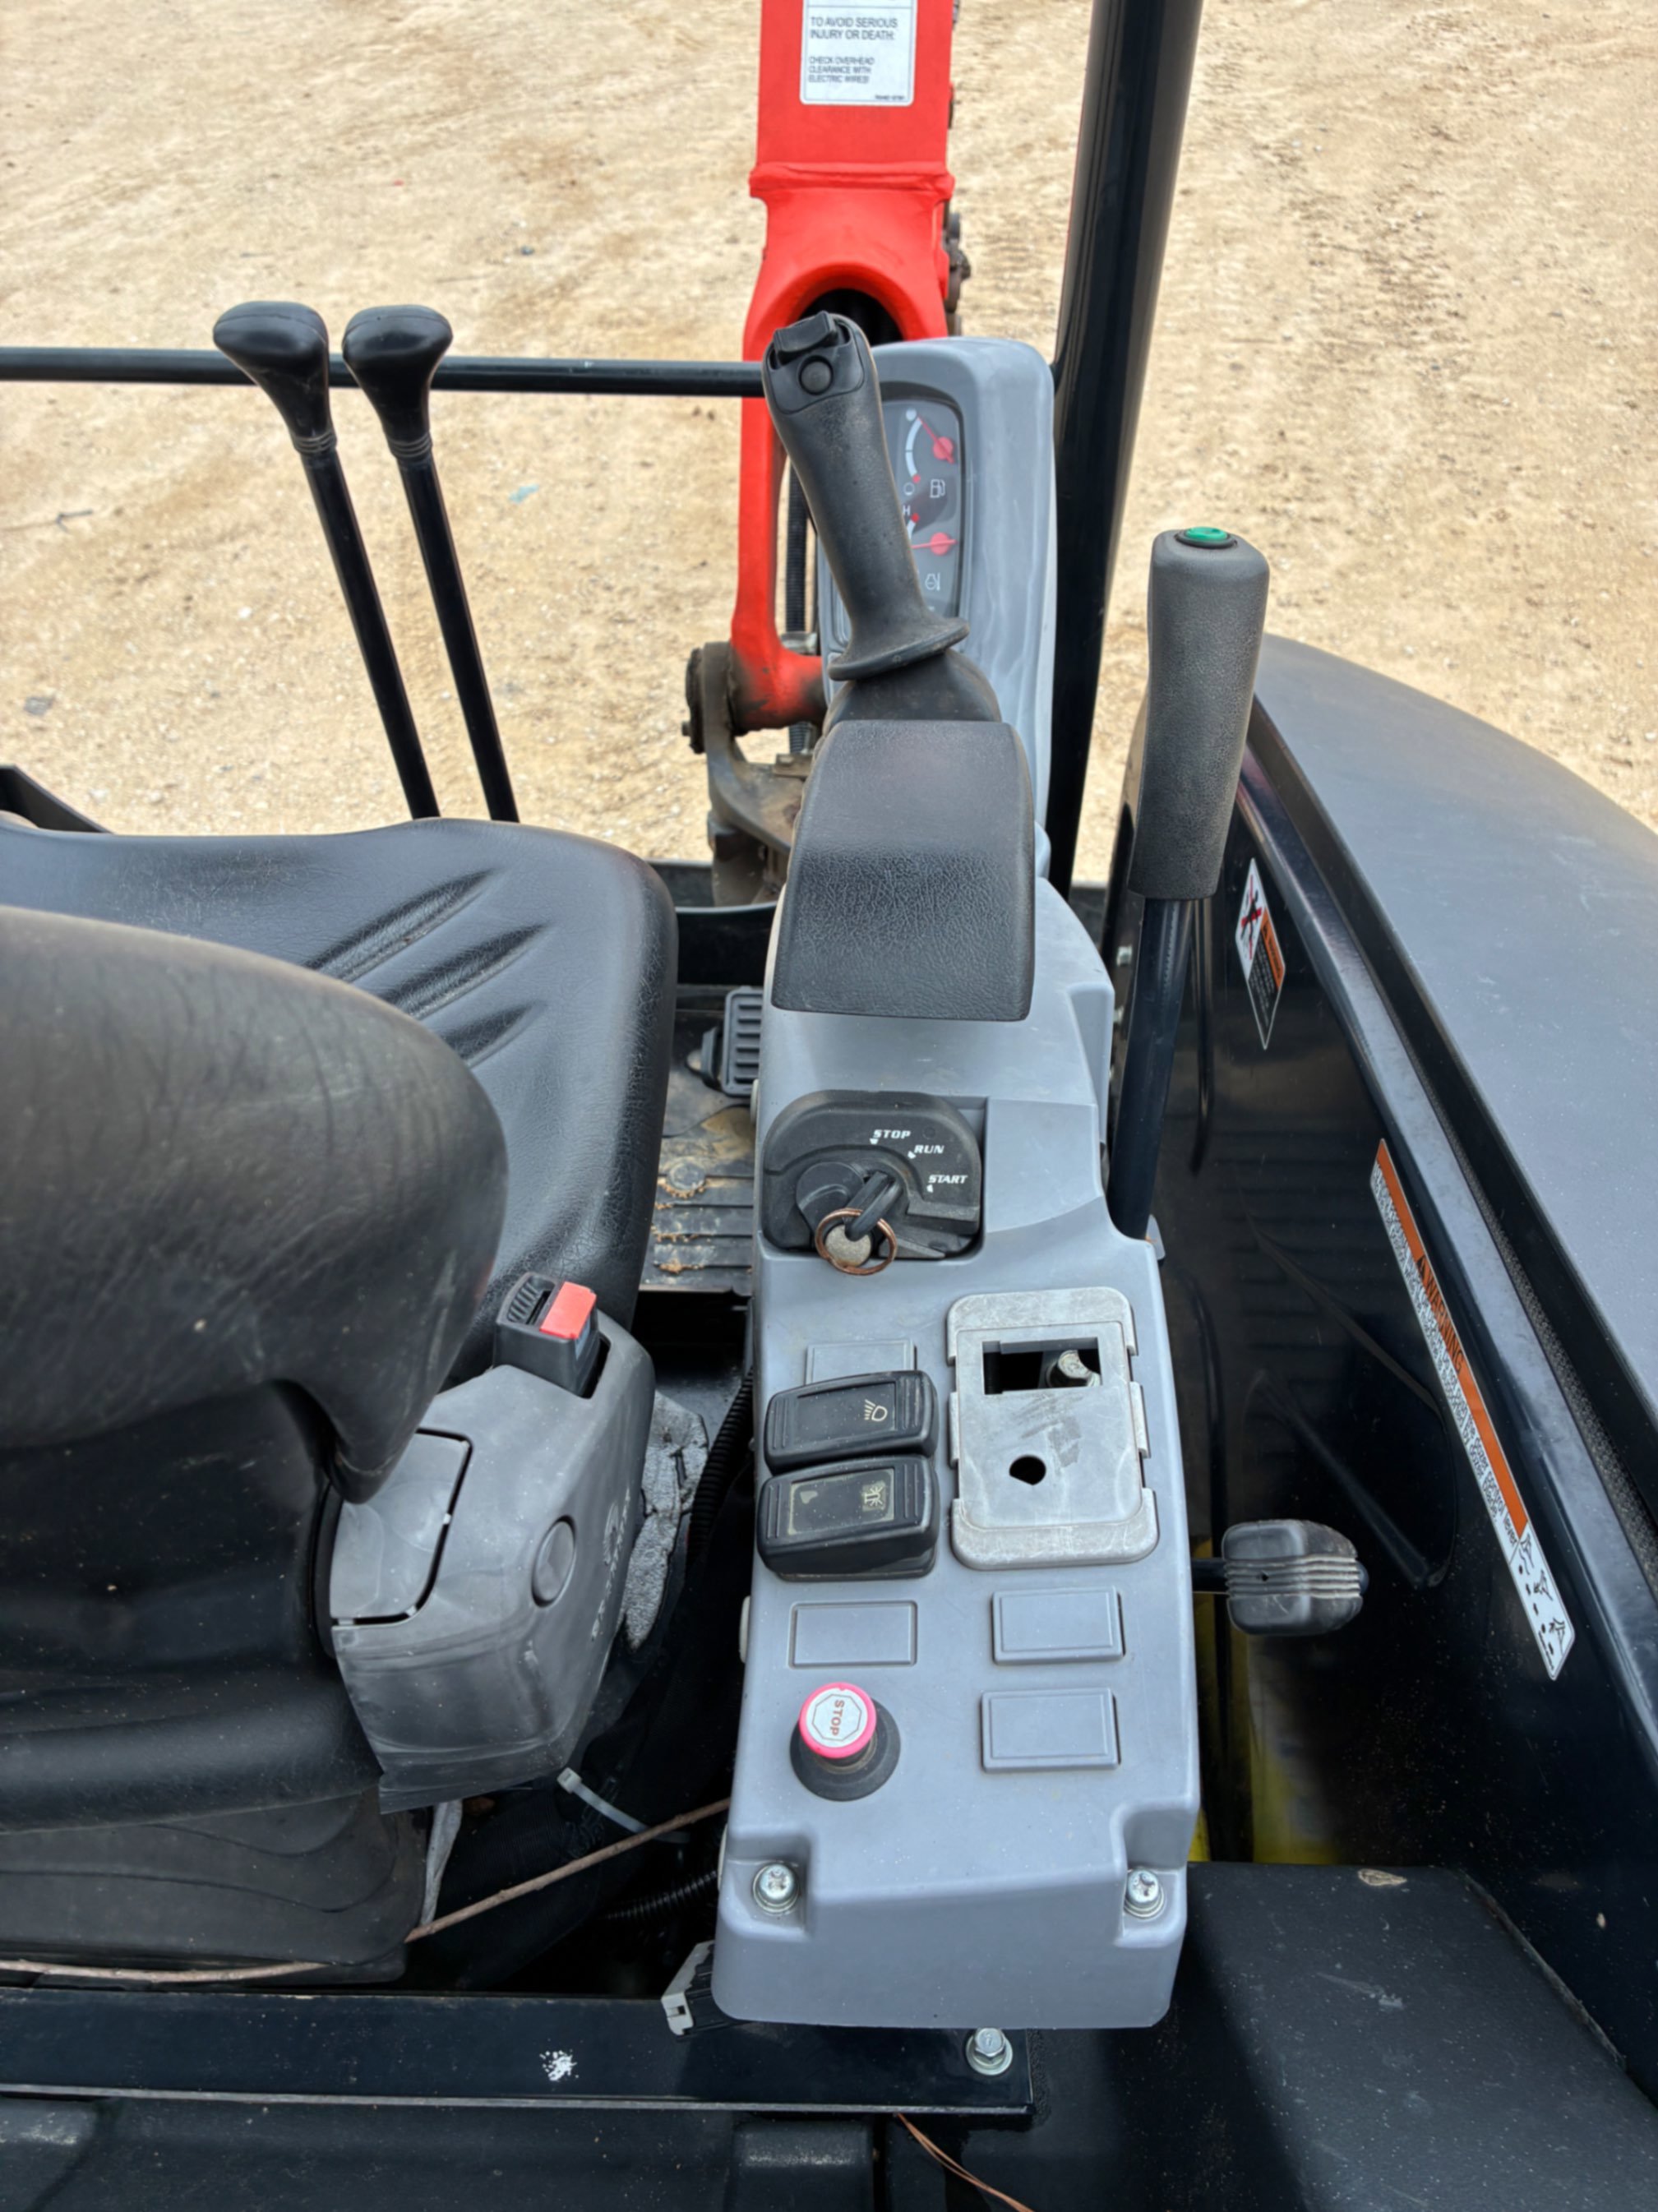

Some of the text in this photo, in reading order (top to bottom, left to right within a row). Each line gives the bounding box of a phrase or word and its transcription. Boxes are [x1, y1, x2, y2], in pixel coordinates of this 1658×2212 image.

[811, 16, 898, 28] TO AVOID SERIOUS
[811, 29, 843, 39] INJURY
[845, 30, 860, 39] OR
[809, 56, 875, 65] CHECK OVERHEAD
[809, 66, 850, 74] CLEARANCE
[808, 75, 843, 83] ELECTRIC
[873, 1129, 911, 1139] STOP
[913, 1144, 944, 1154] RUN
[928, 1175, 968, 1185] START
[1425, 1269, 1464, 1376] WARNING
[1503, 1511, 1519, 1550] lever
[830, 1699, 845, 1736] STOP
